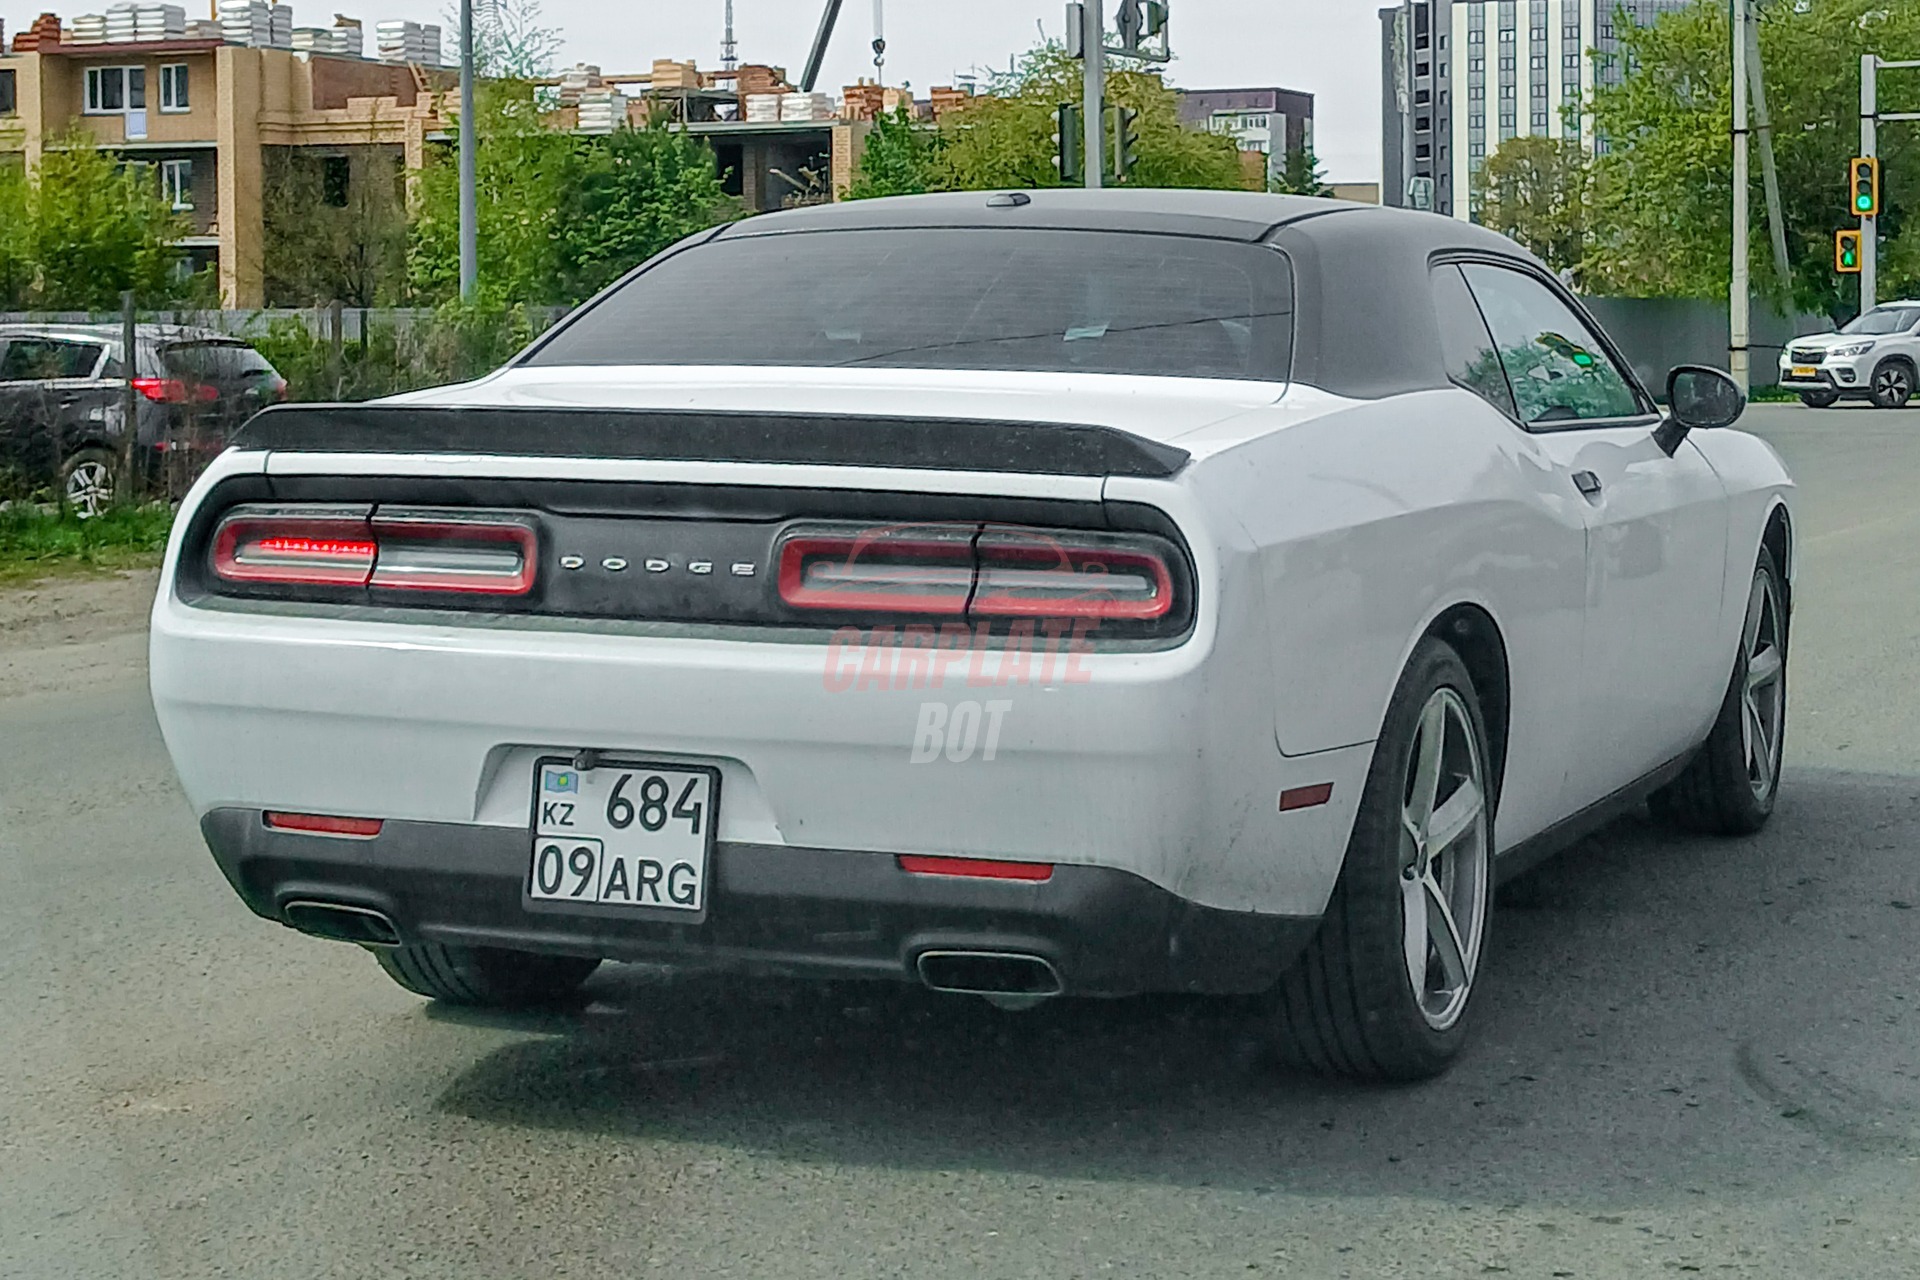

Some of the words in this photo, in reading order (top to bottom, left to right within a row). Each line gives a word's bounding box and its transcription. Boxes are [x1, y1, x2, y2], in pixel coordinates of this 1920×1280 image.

[560, 555, 756, 576] DODGE
[542, 801, 575, 826] KZ
[606, 773, 702, 835] 684
[537, 844, 595, 897] 09
[603, 857, 697, 906] ARG
